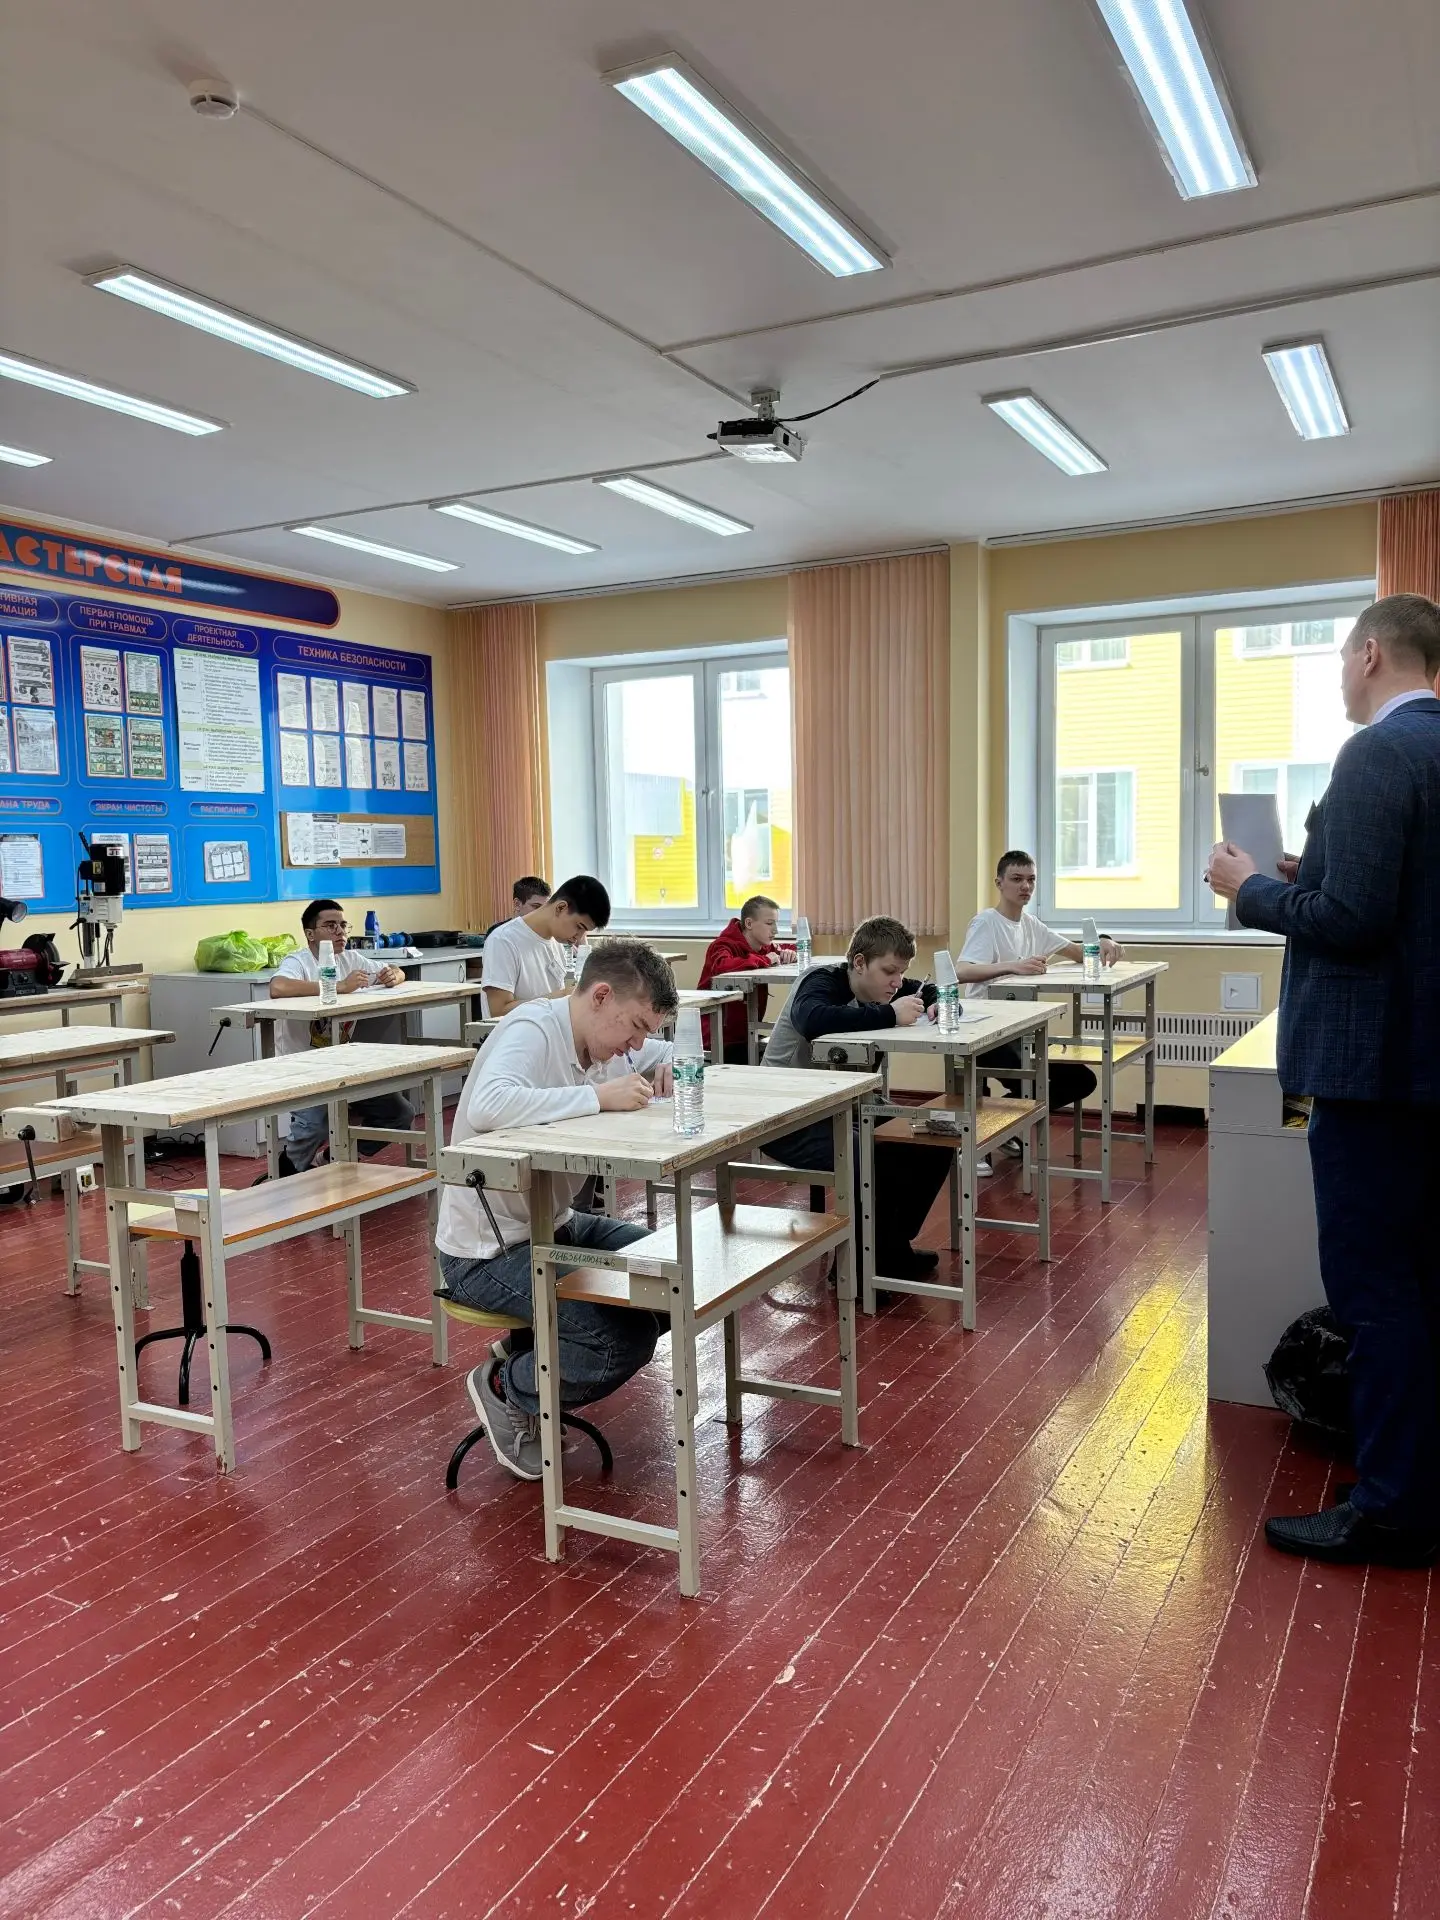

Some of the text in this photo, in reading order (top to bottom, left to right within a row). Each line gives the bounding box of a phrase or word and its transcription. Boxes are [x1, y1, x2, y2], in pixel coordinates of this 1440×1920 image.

[80, 606, 154, 627] ПЕРВАЯ ПОМОЩЬ
[89, 618, 147, 635] ПРИ ТРАВМАХ
[194, 624, 237, 638] ПРОЕКТНАЯ
[187, 633, 245, 649] ДЕЯТЕЛЬНОСТЬ
[297, 645, 407, 672] ТЕХНИКА БЕЗОПАСНОСТИ
[21, 800, 50, 810] ТРУДА
[95, 803, 163, 813] ЭКРАН ЧИСТОТЫ
[200, 805, 248, 814] РАСПИСАНИЕ
